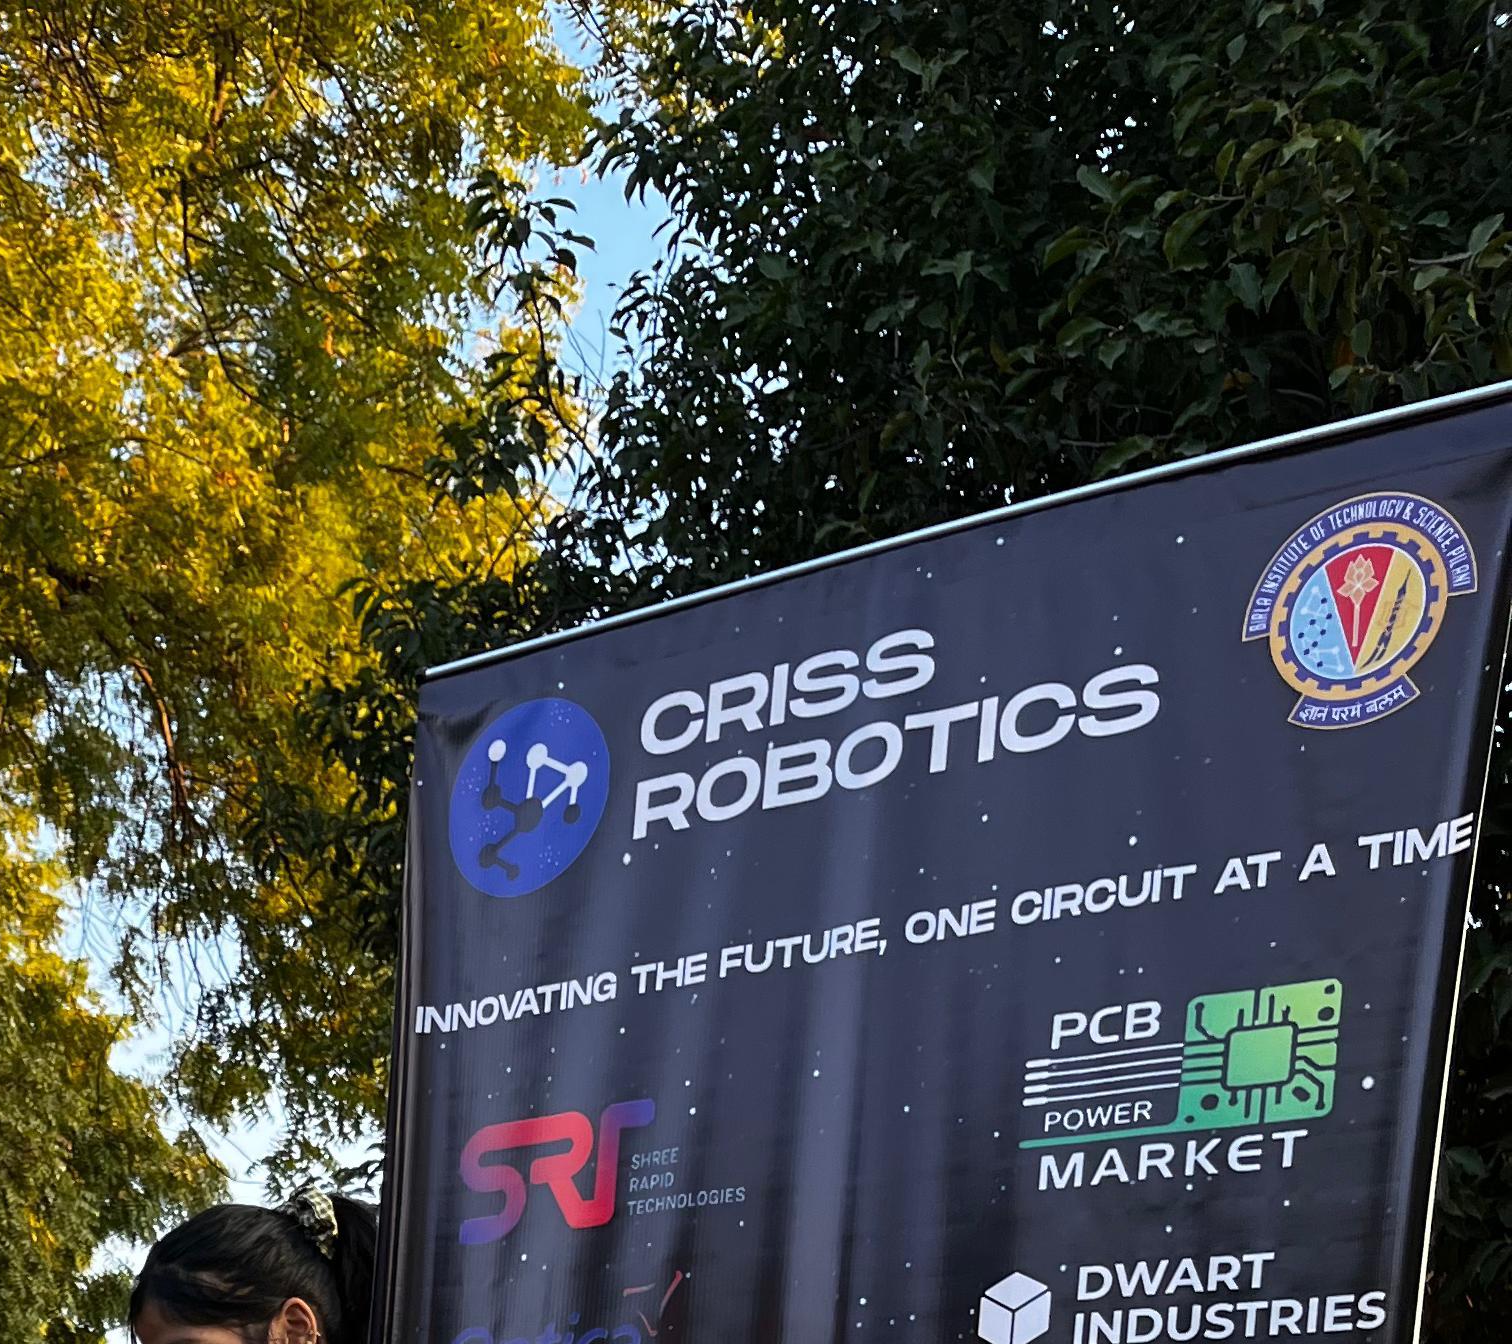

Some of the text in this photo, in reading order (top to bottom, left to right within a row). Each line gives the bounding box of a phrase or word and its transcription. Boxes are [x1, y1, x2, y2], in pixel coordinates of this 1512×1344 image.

[1310, 521, 1327, 541] OF
[1327, 499, 1403, 531] TECHNOLOGY
[1259, 533, 1312, 595] INSTITUTE
[1448, 544, 1472, 589] PILANI
[1248, 596, 1273, 634] BIRLA
[640, 629, 935, 757] CRISS
[631, 663, 1162, 840] ROBOTICS
[414, 812, 1476, 1034] INNOVATING THE FUTURE, ONE CIRCUIT AT A TIME
[1050, 1000, 1163, 1051] PCB
[1044, 1100, 1154, 1133] POWER
[630, 1147, 680, 1171] SHREE
[1037, 1129, 1309, 1191] MARKET
[626, 1186, 747, 1218] TECHNOLOGIES
[628, 1172, 675, 1193] RAPID
[1077, 1251, 1276, 1301] DWART
